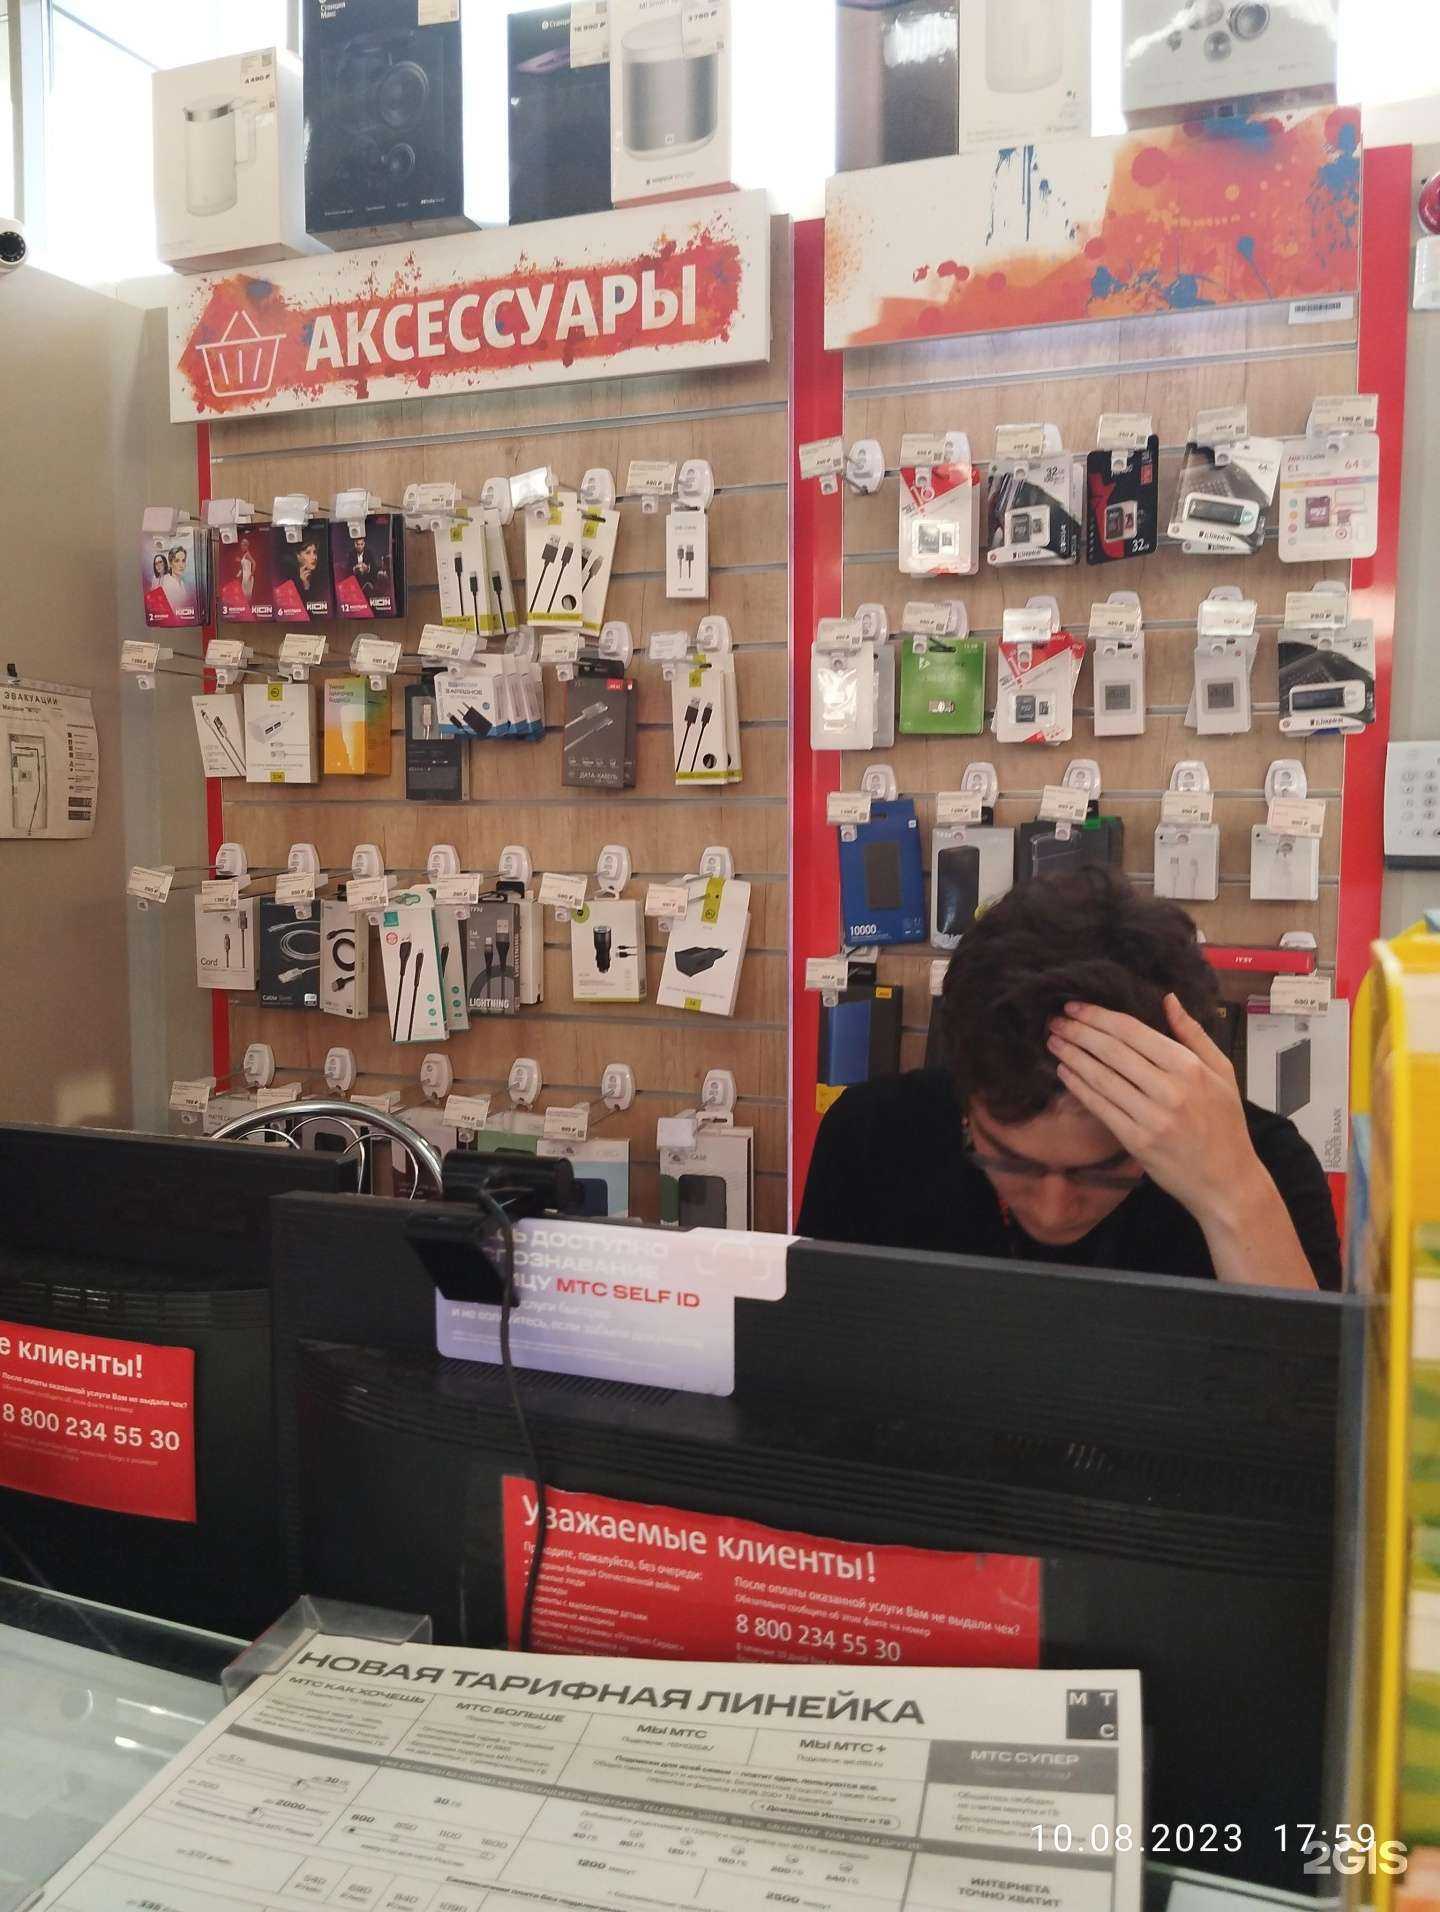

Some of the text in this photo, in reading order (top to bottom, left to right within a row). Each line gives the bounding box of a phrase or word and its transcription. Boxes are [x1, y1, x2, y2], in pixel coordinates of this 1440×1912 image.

[305, 264, 697, 371] АКСЕССУАРЫ
[1131, 538, 1144, 552] 32
[222, 606, 228, 614] 3
[251, 606, 273, 614] KION
[278, 608, 283, 616] 6
[306, 602, 328, 611] KION
[341, 604, 349, 612] 12
[4, 691, 58, 704] ЭВАКУАЦИИ
[850, 924, 877, 936] 10000
[200, 957, 218, 967] Cord
[469, 998, 510, 1009] LIGHTNING
[612, 1282, 671, 1304] SELF
[676, 1291, 701, 1308] ID
[18, 1340, 144, 1380] клиенты!
[2, 1402, 15, 1423] 8
[20, 1406, 60, 1432] 800
[65, 1416, 107, 1442] 234
[113, 1425, 143, 1447] 55
[149, 1429, 180, 1451] 30
[522, 1493, 877, 1583] Уважаемые клиенты!
[734, 1576, 767, 1593] После
[735, 1613, 748, 1634] 8
[754, 1617, 792, 1642] 800
[797, 1624, 836, 1651] 234
[842, 1632, 868, 1655] 55
[873, 1637, 901, 1662] 30
[298, 1650, 925, 1726] НОВАЯ ТАРИФНАЯ ЛИНЕЙКА
[324, 1683, 356, 1696] КАК
[357, 1688, 425, 1704] ХОЧЕШЬ
[493, 1706, 566, 1723] БОЛЬШЕ
[636, 1723, 708, 1739] МЫ МТС
[799, 1738, 831, 1750] МЫ
[833, 1740, 873, 1753] МТС
[1014, 1751, 1081, 1766] СУПЕР
[576, 1856, 607, 1869] 1200
[969, 1876, 1051, 1894] ИНТЕРНЕТА
[766, 1891, 801, 1904] 2500
